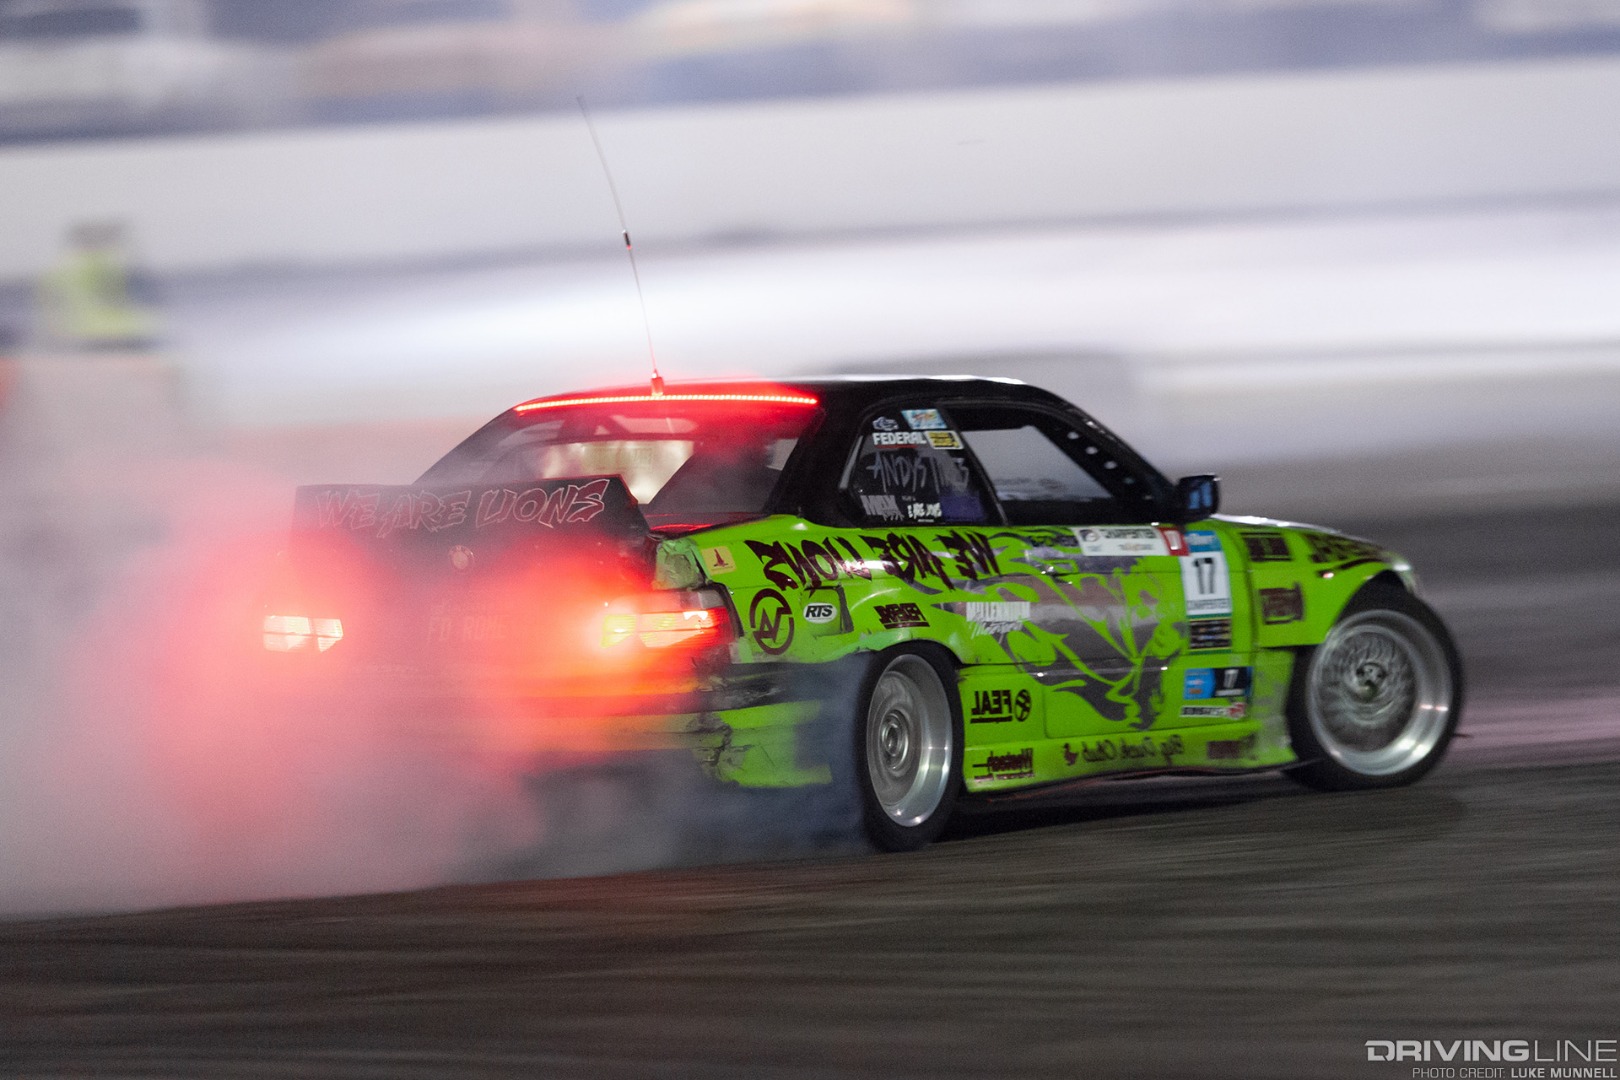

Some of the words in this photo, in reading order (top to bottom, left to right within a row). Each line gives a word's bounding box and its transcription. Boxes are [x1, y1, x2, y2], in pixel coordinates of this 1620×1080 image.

[872, 431, 927, 445] FEDERAL
[315, 488, 381, 530] WE
[375, 489, 472, 538] ARE
[475, 479, 611, 528] LIONS
[805, 604, 833, 618] RTS
